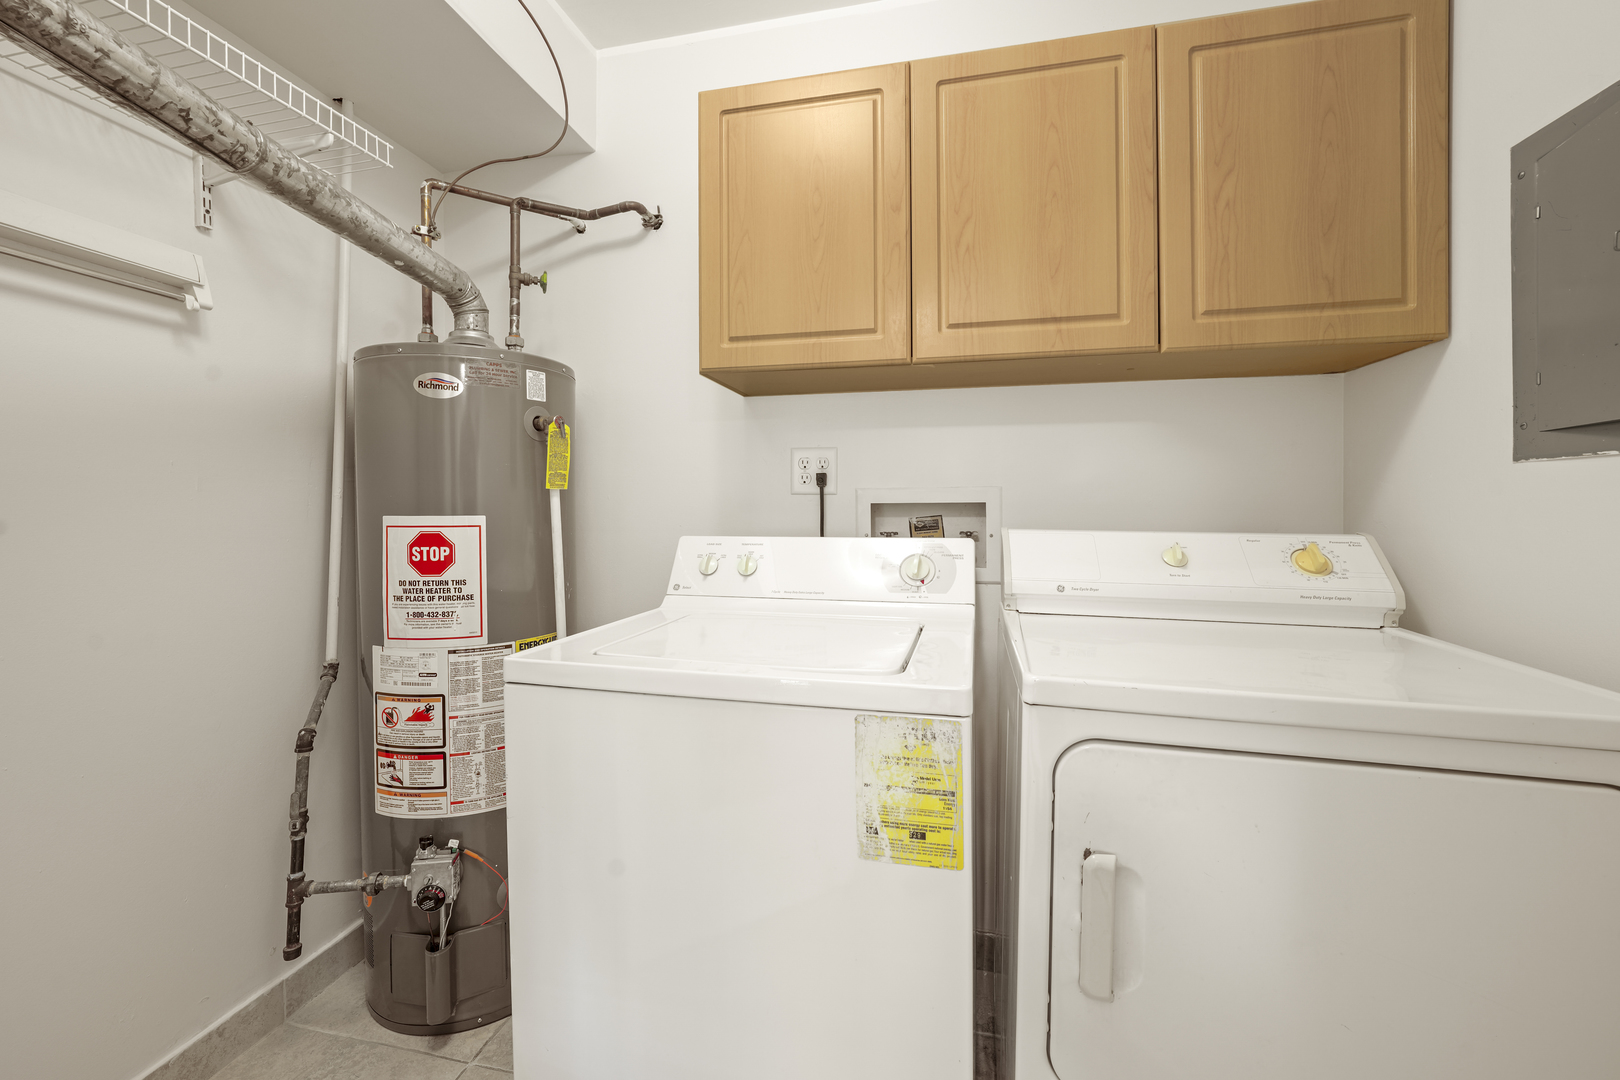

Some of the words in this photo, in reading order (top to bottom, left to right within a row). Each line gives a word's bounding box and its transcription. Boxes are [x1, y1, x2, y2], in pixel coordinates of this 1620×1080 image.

[418, 380, 459, 392] Richmond
[412, 546, 450, 562] STOP
[438, 594, 474, 602] PURCHASE
